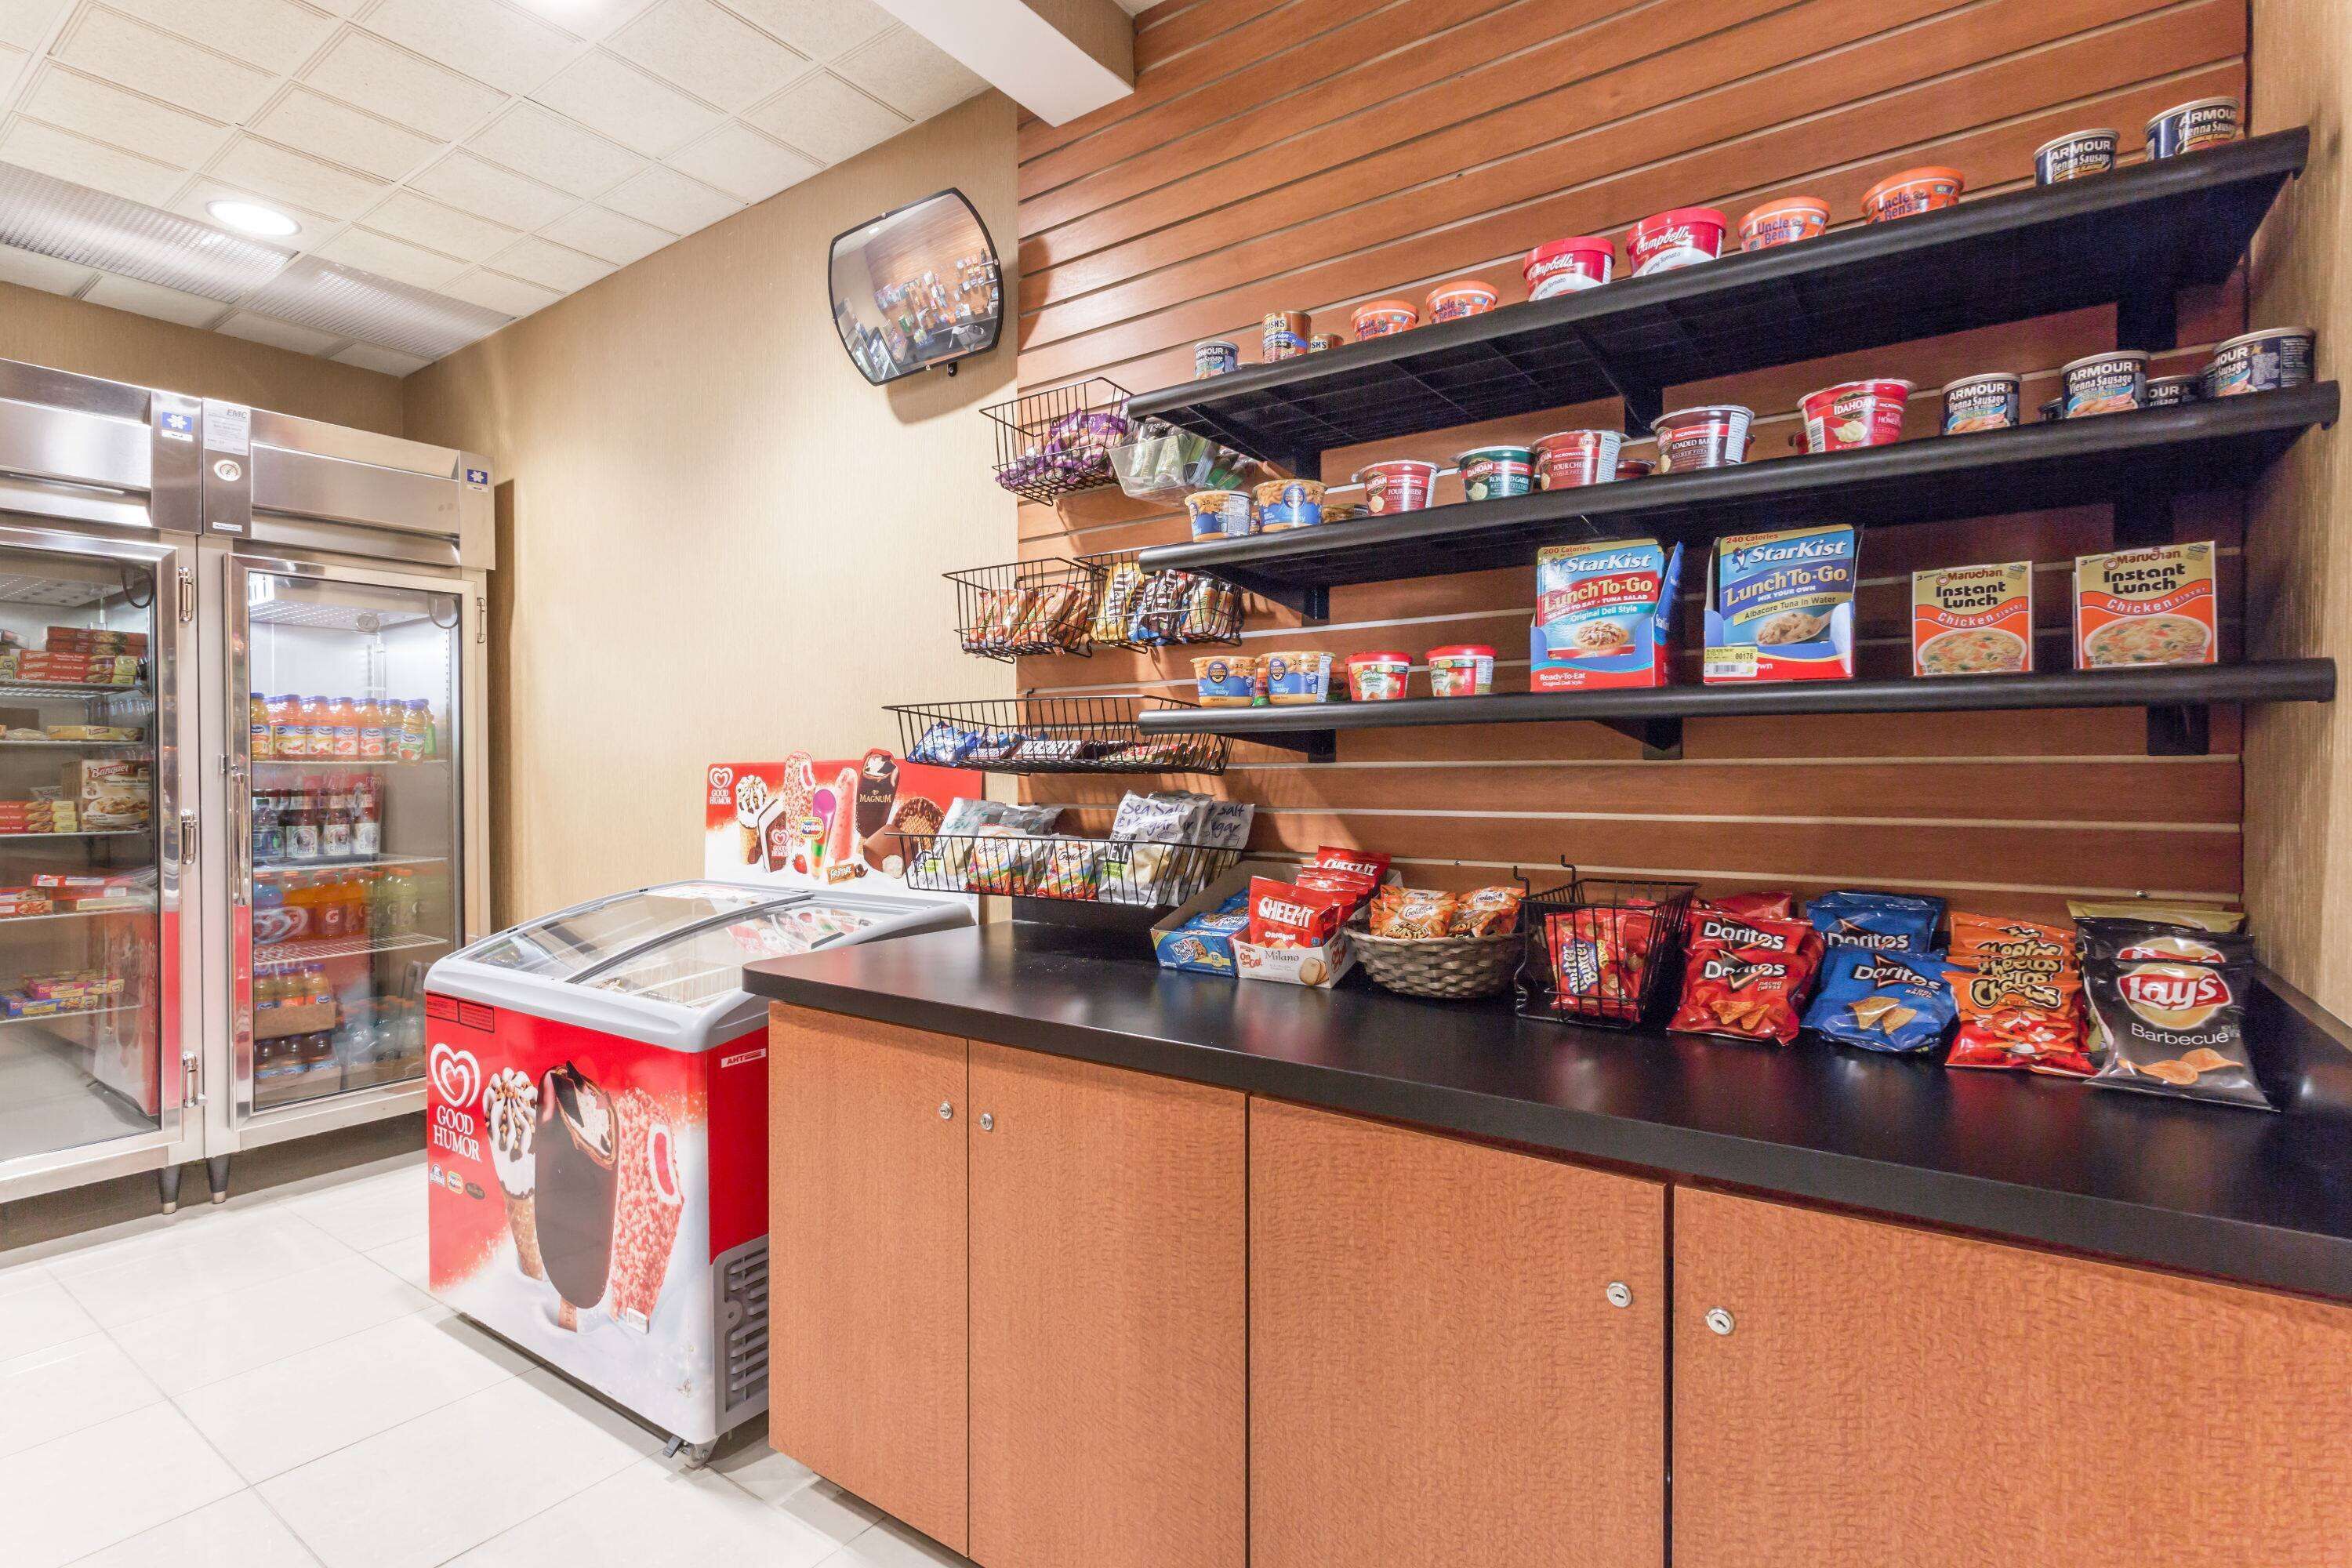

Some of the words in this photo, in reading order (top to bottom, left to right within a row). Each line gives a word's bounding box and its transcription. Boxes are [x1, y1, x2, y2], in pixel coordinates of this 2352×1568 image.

[2051, 140, 2111, 160] ARMOUR
[1758, 217, 1789, 234] Uncle
[1637, 226, 1690, 254] Campbell's
[1529, 253, 1575, 281] Campbell's
[2070, 361, 2132, 382] ARMOUR
[1950, 383, 2005, 402] ARMOUR
[2070, 380, 2096, 394] Vienna
[2096, 375, 2132, 387] Sausage
[2148, 386, 2180, 399] OUR
[1834, 396, 1877, 416] IDAHOAN
[1973, 395, 2005, 407] Sausage
[226, 408, 247, 419] EMC
[1672, 439, 1697, 450] LOADED
[1745, 532, 1779, 543] Calories
[1750, 539, 1848, 564] StarKist
[2117, 547, 2182, 564] Maruchan
[1565, 553, 1653, 574] StarKist
[1947, 569, 2003, 581] Maruchan
[2103, 563, 2186, 583] Instant
[1723, 572, 1786, 607] Lunch
[1786, 565, 1847, 586] To-Go
[1773, 588, 1795, 597] YOUR
[1797, 585, 1817, 593] OWN
[1936, 581, 2006, 597] Instant
[2113, 578, 2177, 595] Lunch
[1542, 581, 1597, 614] Lunch
[1943, 594, 1998, 608] Lunch
[2107, 598, 2172, 614] Chicken
[1570, 603, 1581, 612] TO
[1570, 610, 1600, 622] Original
[1602, 607, 1617, 615] Deli
[1617, 605, 1638, 614] Style
[1744, 604, 1778, 620] Albacore
[1780, 600, 1799, 609] Tuna
[1810, 596, 1836, 604] Water
[1937, 612, 1994, 626] Chicken
[91, 764, 129, 779] Banquet
[859, 793, 891, 803] MAGNUM
[1122, 802, 1150, 816] Sea
[1152, 804, 1186, 817] Salt
[1704, 921, 1785, 950] Doritos
[1828, 931, 1910, 949] Doritos
[1240, 952, 1251, 962] On
[1265, 949, 1300, 963] Milano
[1853, 965, 1942, 990] Doritos
[2132, 1022, 2229, 1046] Barbecue
[727, 1055, 743, 1065] AHT
[436, 1105, 474, 1136] GOOD
[433, 1124, 482, 1163] HUMOR
